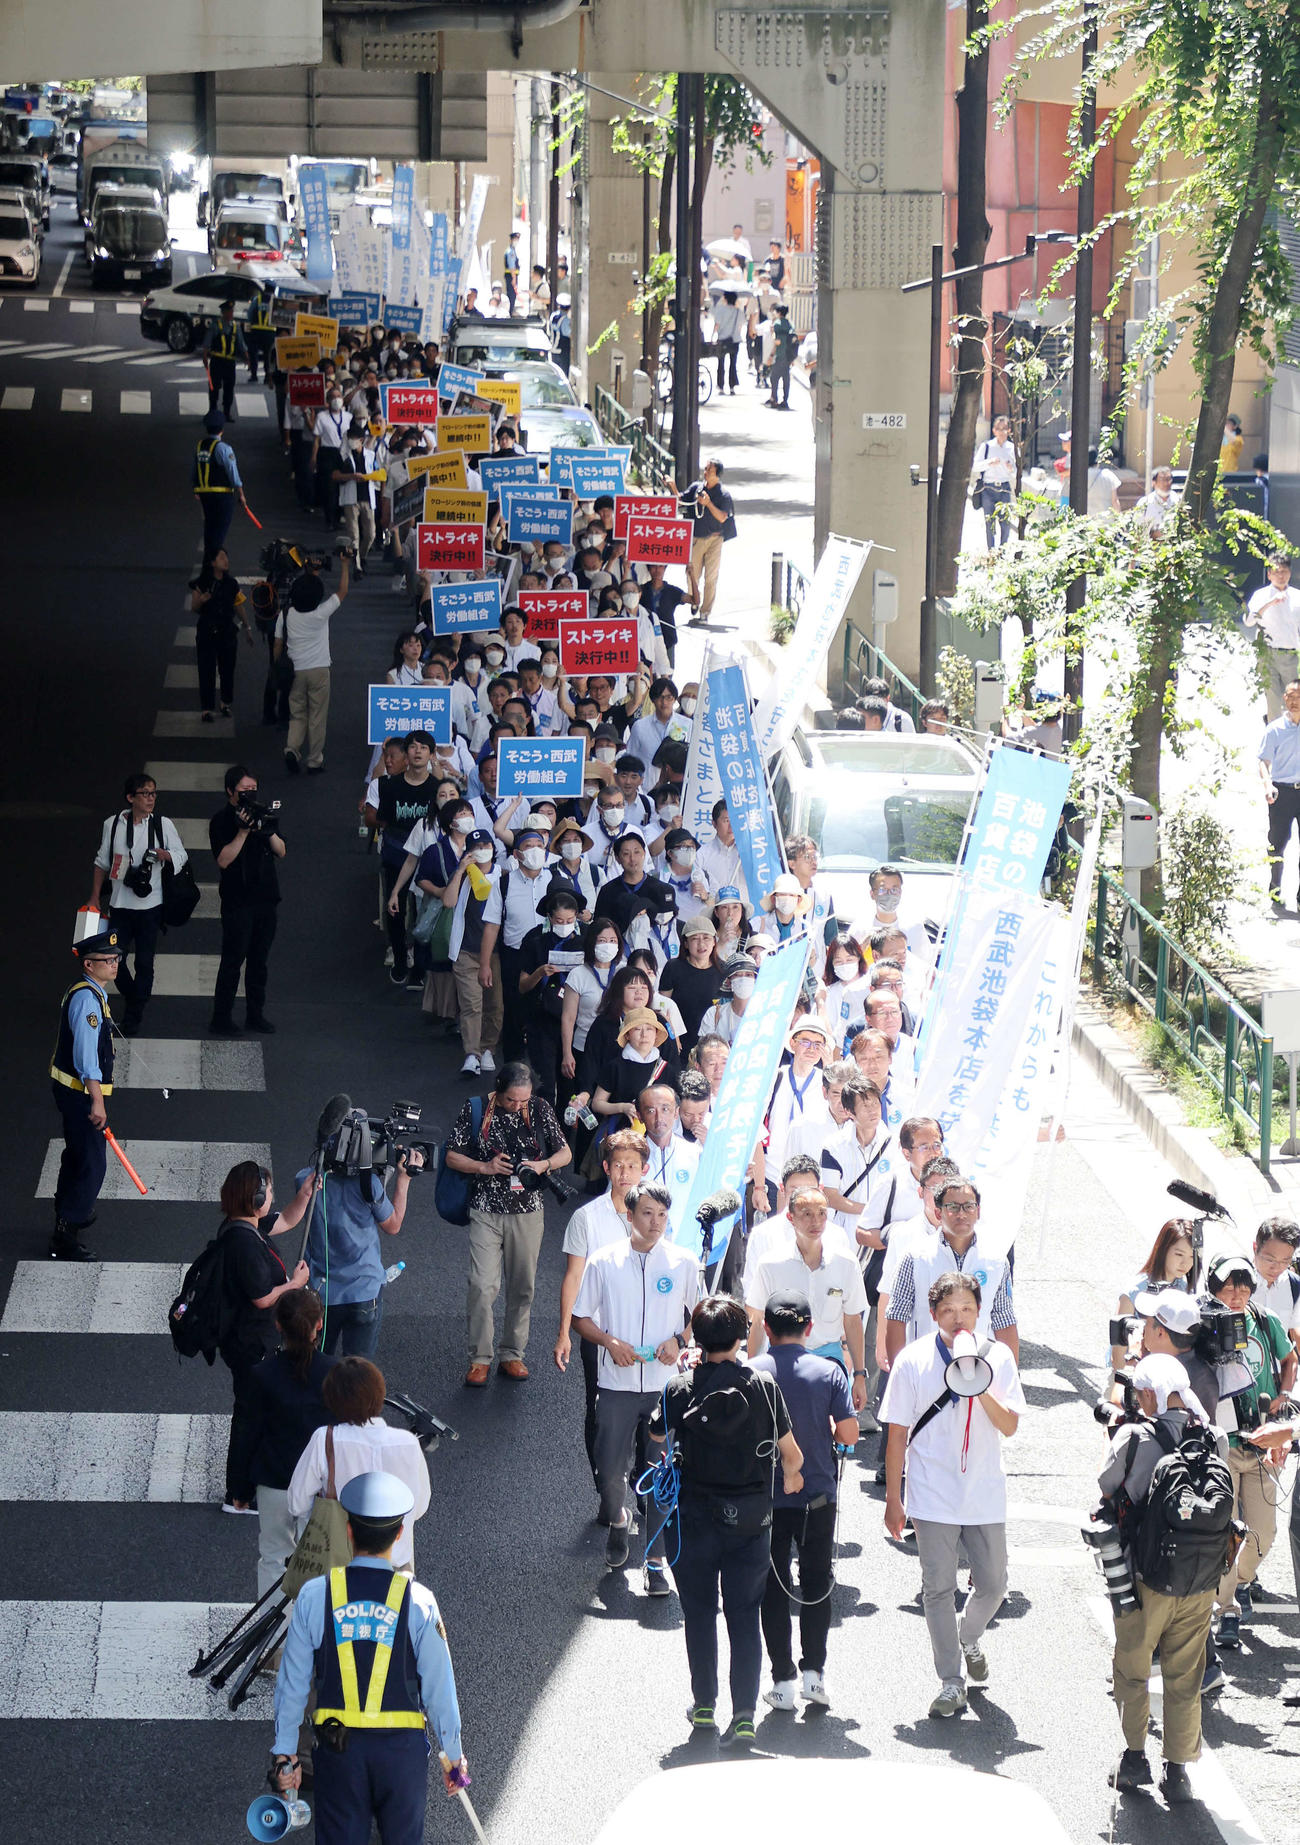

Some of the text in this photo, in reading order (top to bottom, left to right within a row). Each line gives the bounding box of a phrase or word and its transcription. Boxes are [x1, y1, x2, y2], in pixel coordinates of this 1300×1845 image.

[391, 393, 435, 404] ストライキ
[397, 408, 433, 418] 決行中!!
[484, 465, 535, 478] そごう・西武
[575, 465, 620, 477] そごう・西武
[582, 480, 616, 491] 労働組合
[515, 506, 568, 521] そごう・西武
[619, 503, 673, 516] ストライキ
[520, 523, 561, 536] 労働組合
[633, 525, 688, 540] ストライキ
[423, 532, 479, 544] ストライキ
[429, 550, 476, 562] 決行中!!
[638, 543, 683, 557] 決行中!!
[437, 590, 496, 607] そごう・西武
[523, 599, 583, 613] ストライキ
[446, 608, 490, 624] 労働組合
[566, 629, 633, 645] ストライキ
[575, 650, 629, 665] 決行中!!
[376, 697, 446, 713] そごう・西武
[384, 717, 437, 732] 労働組合
[505, 749, 578, 764] そごう・西武
[513, 769, 569, 785] 労働組合
[472, 831, 481, 840] C
[1012, 960, 1058, 1112] これからも
[333, 1604, 398, 1625] POLICE
[341, 1624, 389, 1639] 警視庁
